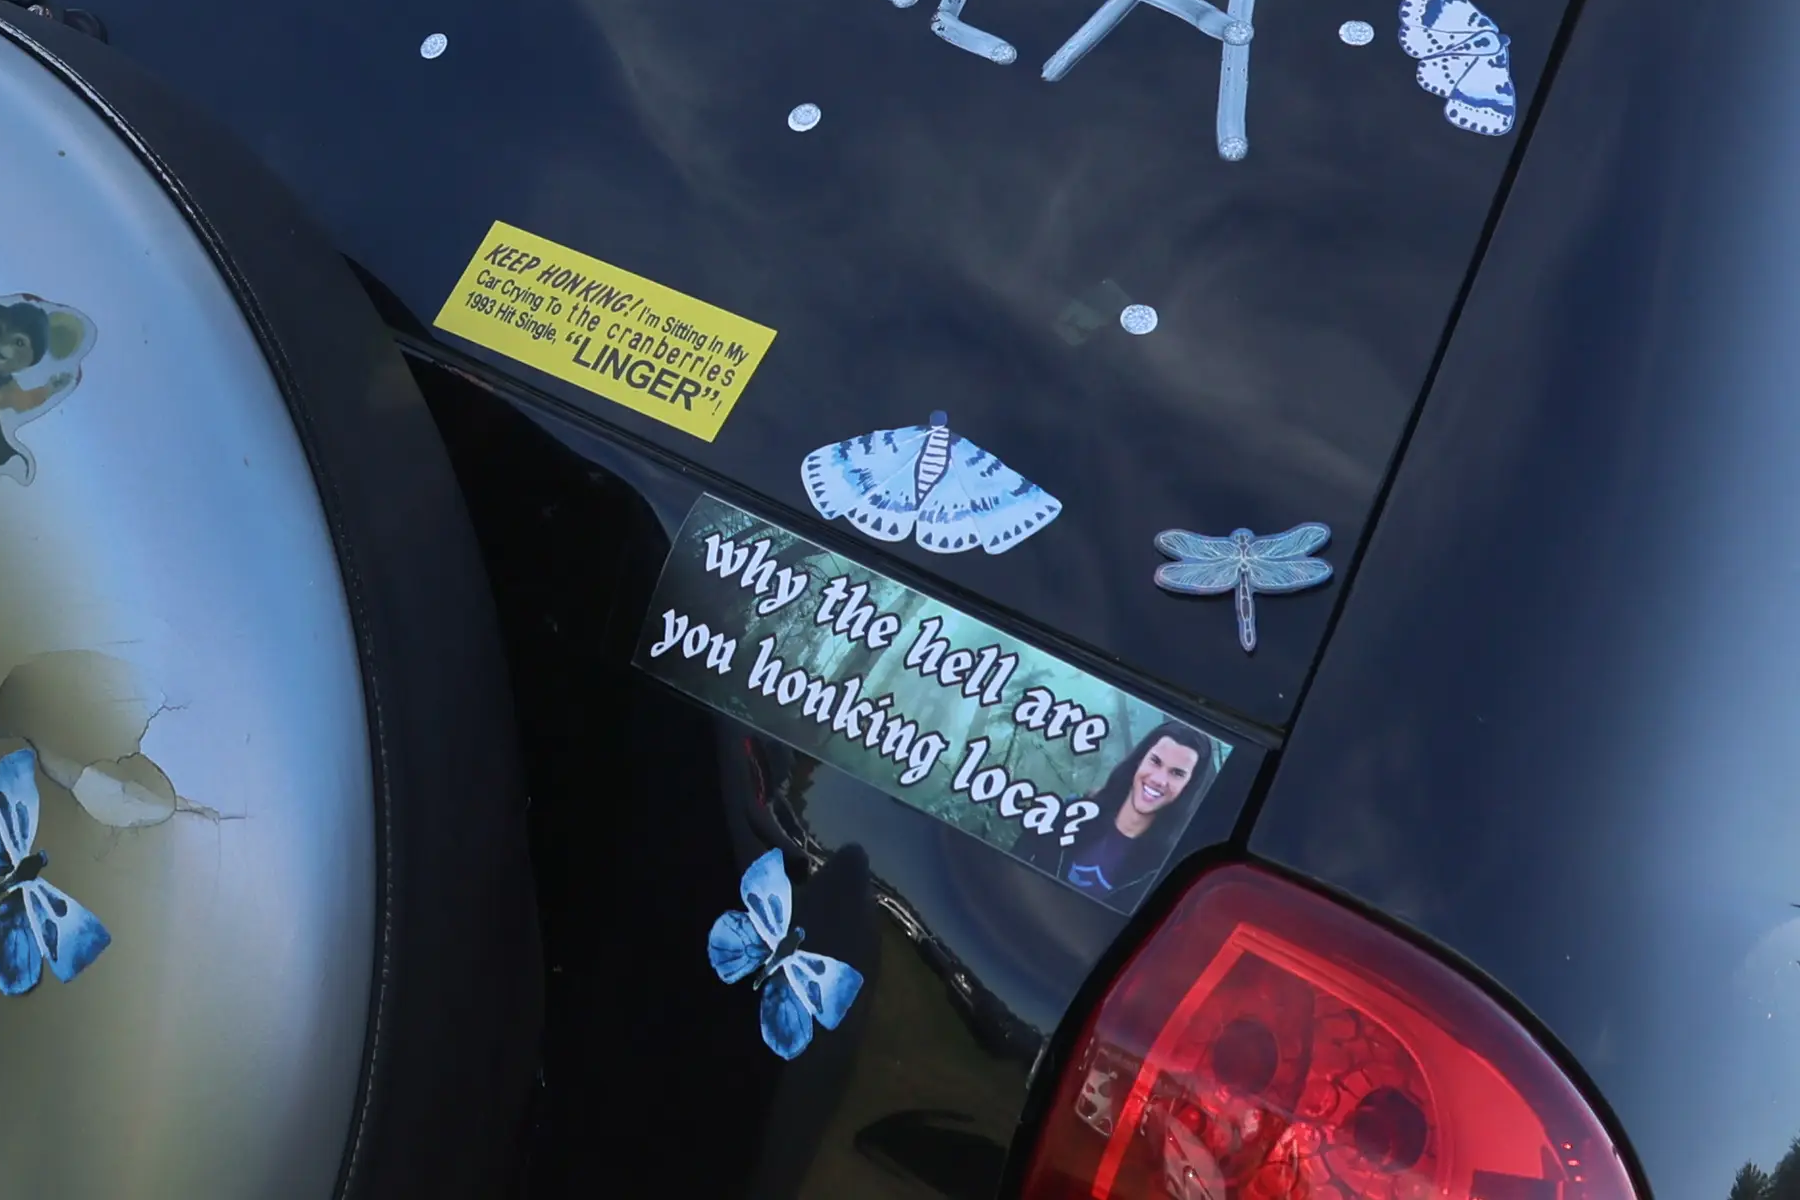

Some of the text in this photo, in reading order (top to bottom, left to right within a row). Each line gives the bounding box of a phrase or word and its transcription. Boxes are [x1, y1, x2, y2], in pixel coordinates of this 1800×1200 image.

[465, 291, 497, 316] 1993
[494, 302, 516, 324] Hit
[515, 311, 557, 345] Single,
[476, 269, 501, 290] Car
[501, 279, 544, 312] Crying
[545, 295, 562, 315] To
[566, 302, 601, 332] the
[484, 243, 749, 367] KEEP HONKING! I'm Sitting In My
[704, 531, 1110, 755] why the hell are
[650, 608, 1101, 848] you honking loca?
